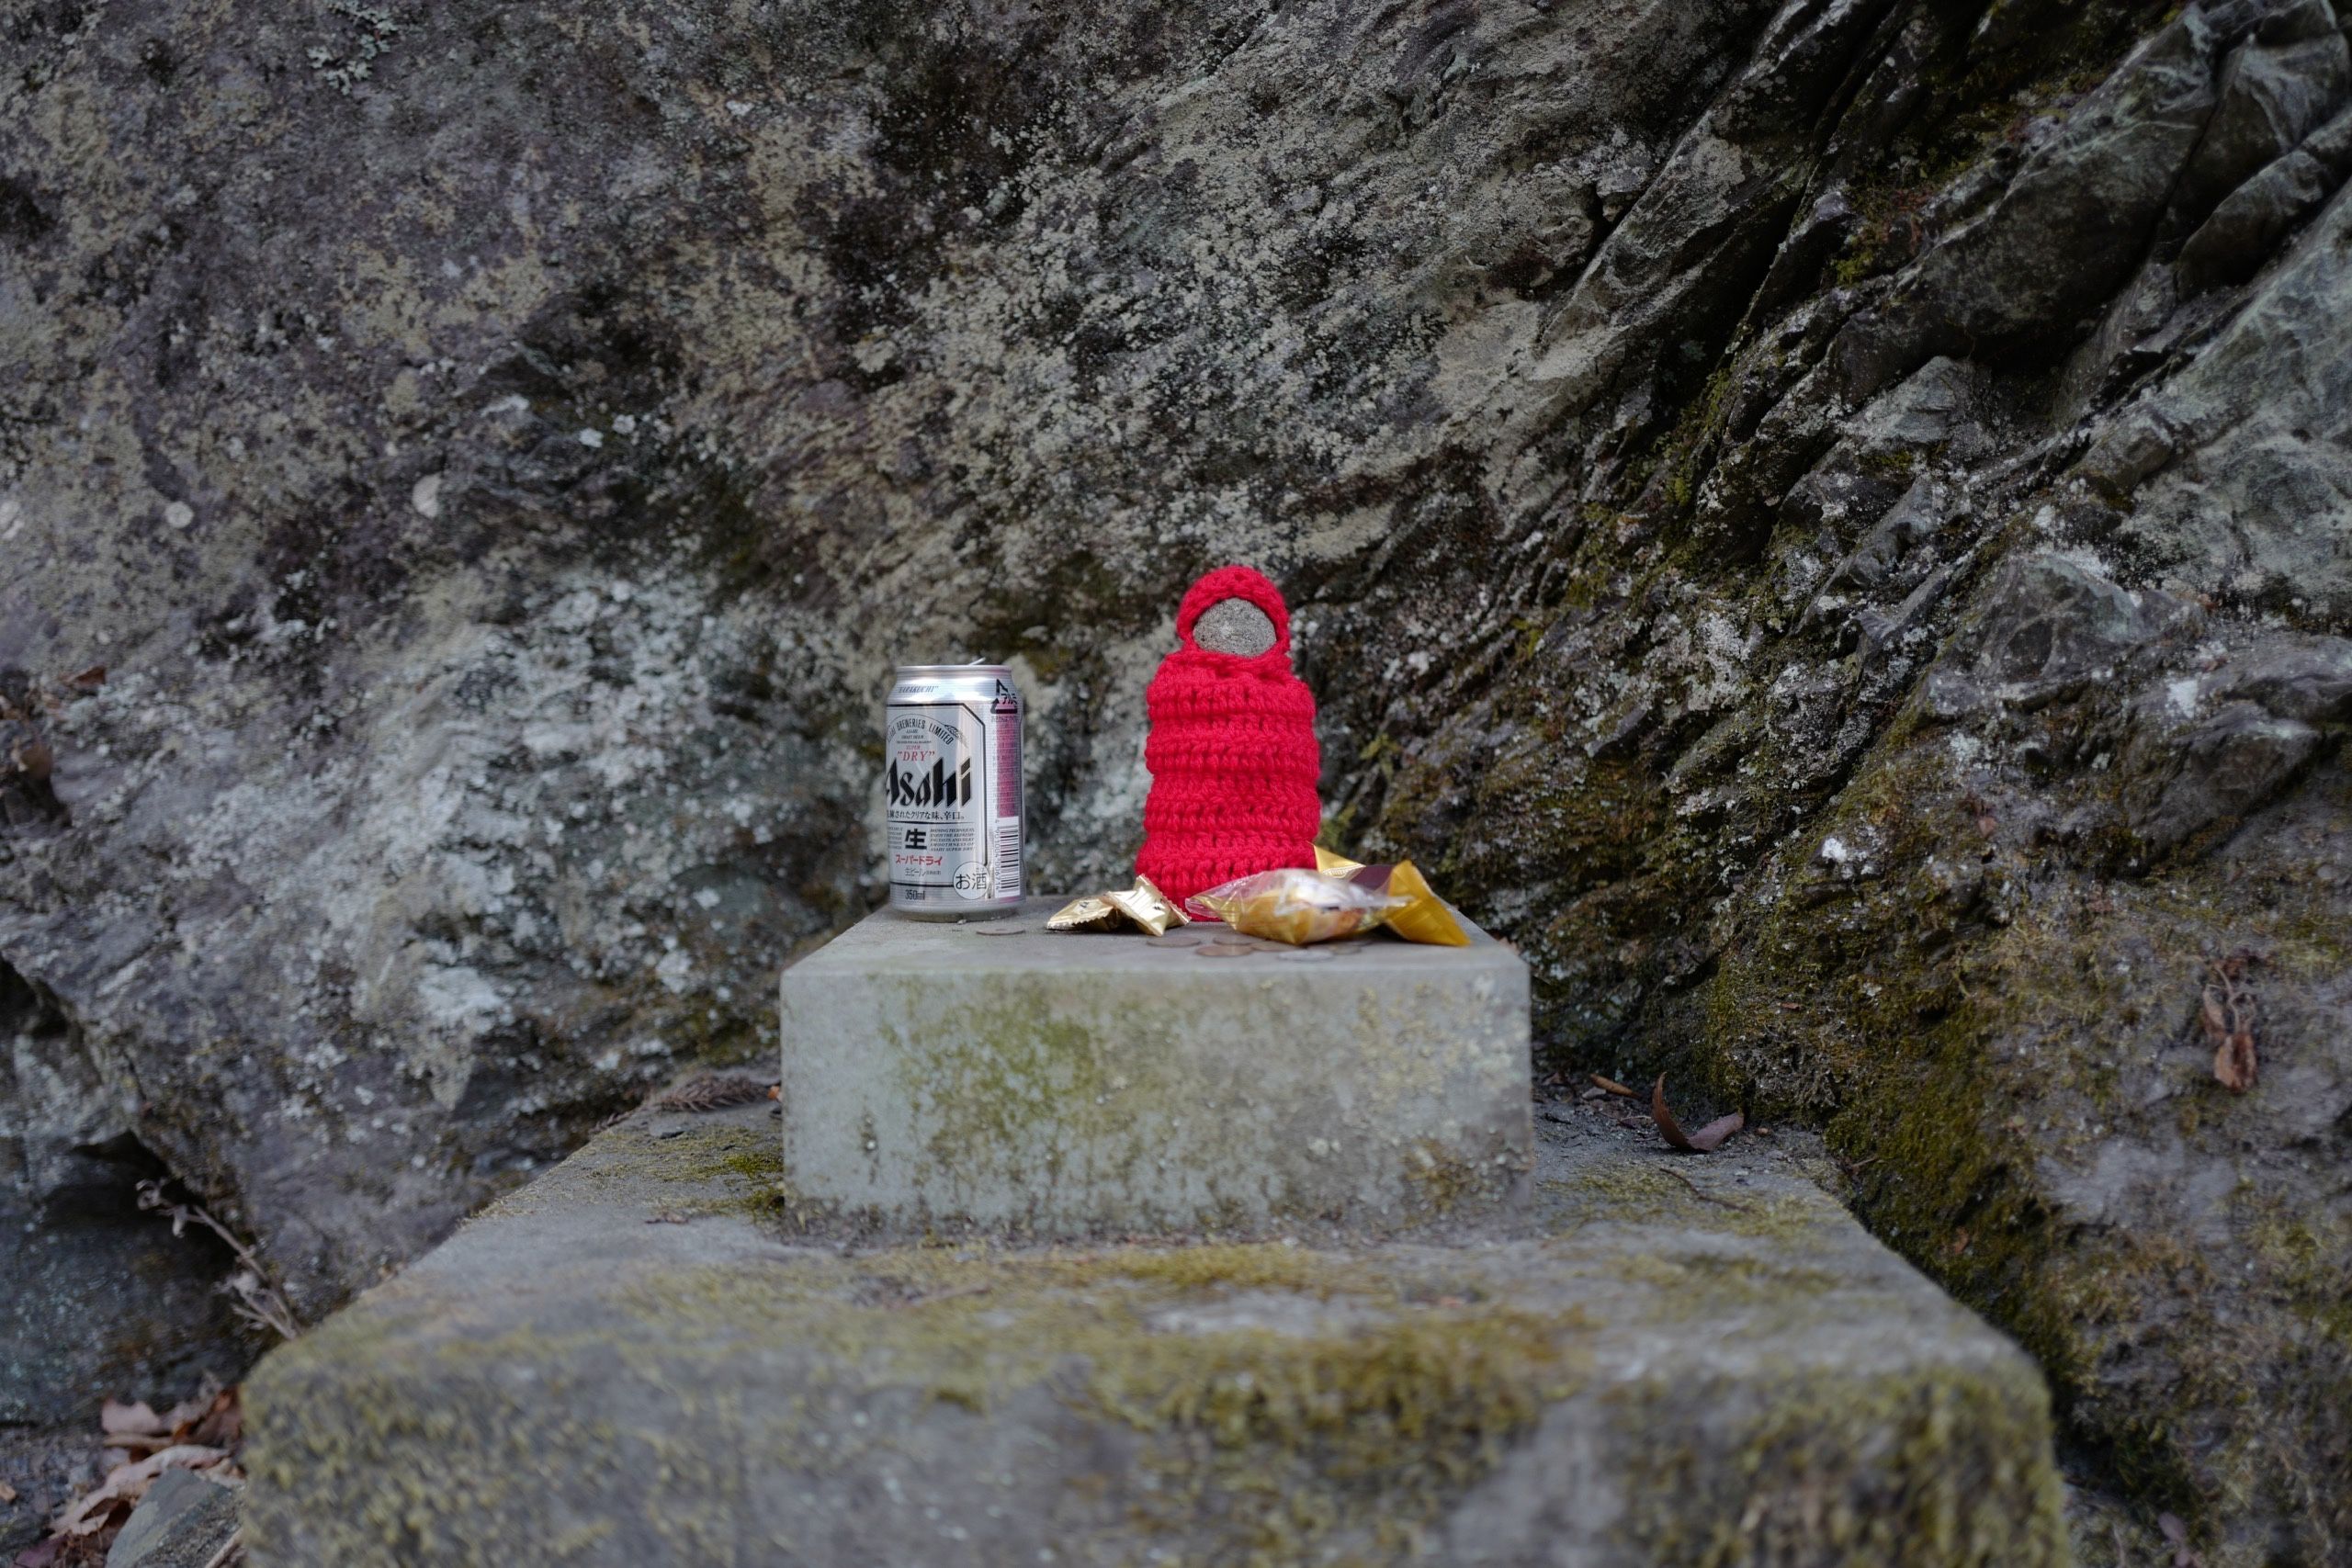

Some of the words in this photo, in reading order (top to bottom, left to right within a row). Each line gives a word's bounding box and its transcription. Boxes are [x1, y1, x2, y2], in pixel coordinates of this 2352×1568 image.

[897, 717, 926, 731] BREWERIES
[928, 723, 955, 745] LIMITED
[885, 757, 971, 808] Asahi
[904, 829, 927, 850] 生
[895, 854, 943, 866] スーパードライ
[955, 873, 988, 890] お酒
[905, 889, 925, 901] 350ml
